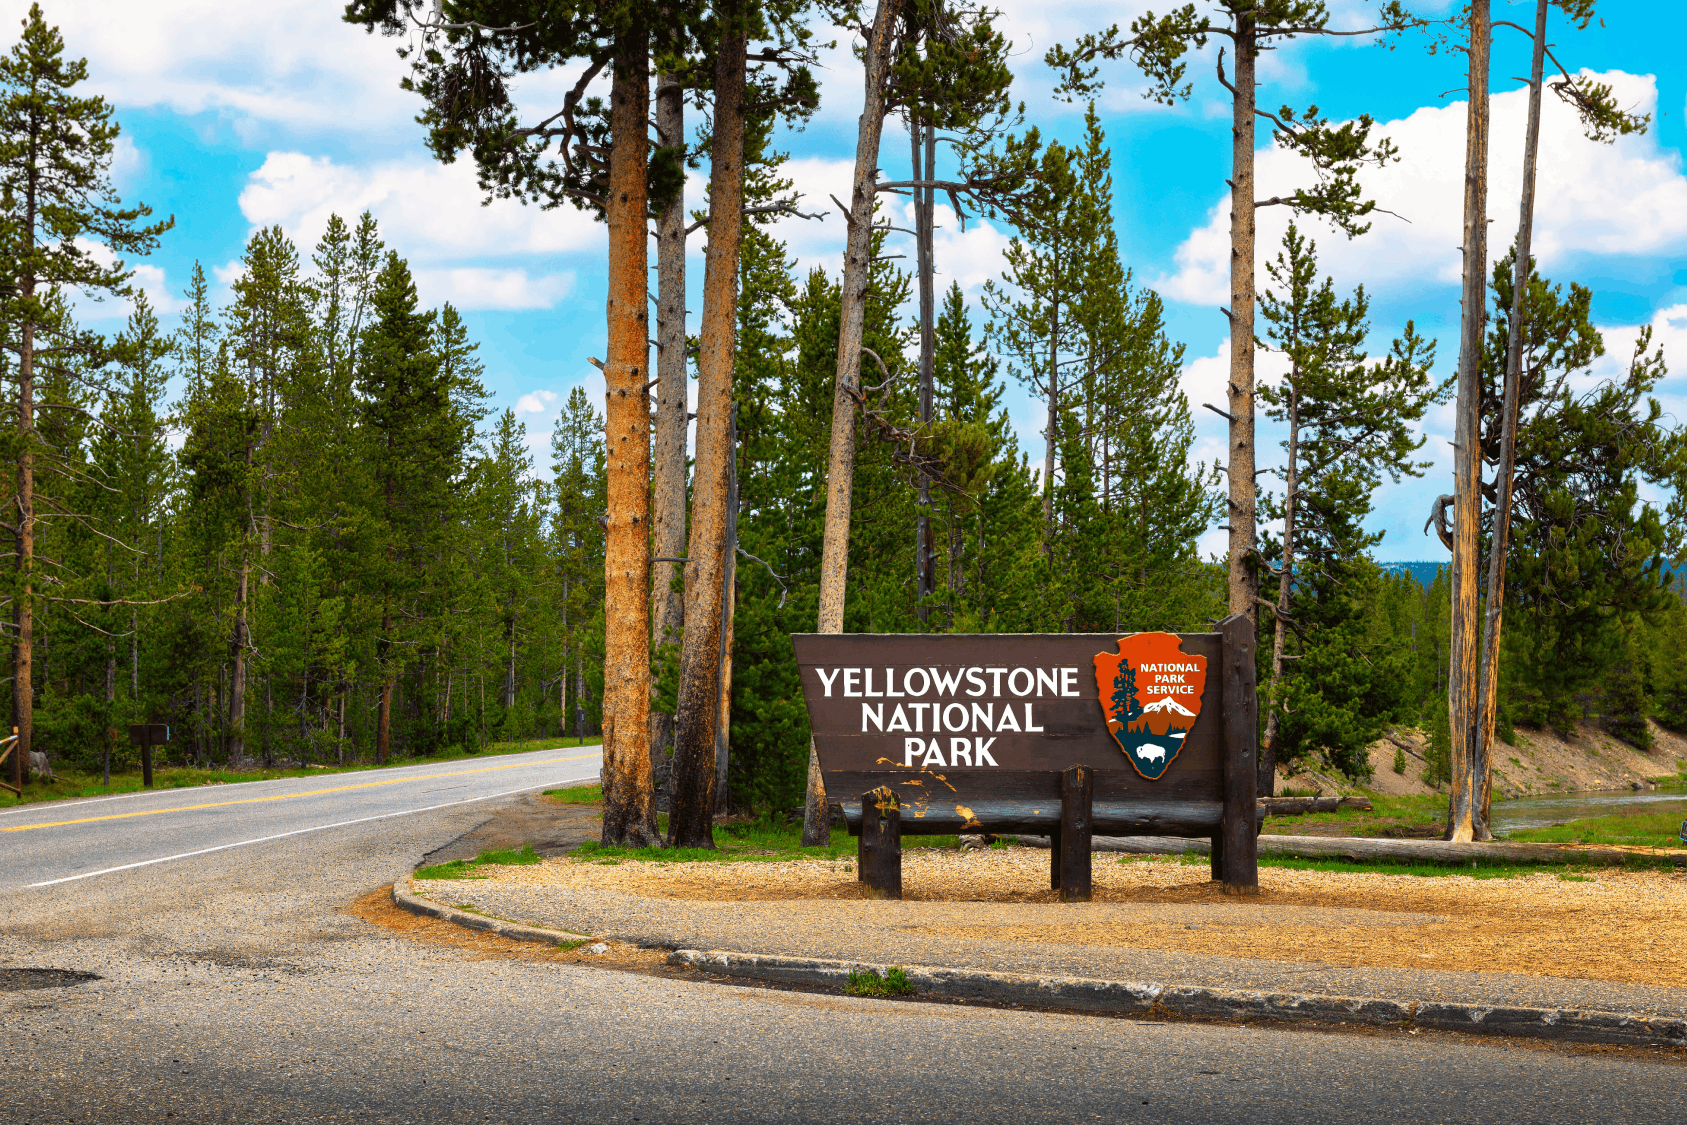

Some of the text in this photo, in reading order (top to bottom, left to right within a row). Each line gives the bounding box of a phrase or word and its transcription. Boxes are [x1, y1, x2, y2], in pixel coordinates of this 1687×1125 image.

[1140, 663, 1200, 673] NATIONAL
[815, 667, 1080, 697] YELLOWSTONE
[1154, 674, 1186, 684] PARK
[1146, 685, 1195, 695] SERVICE
[862, 703, 1043, 732] NATIONAL
[905, 737, 999, 766] PARK
